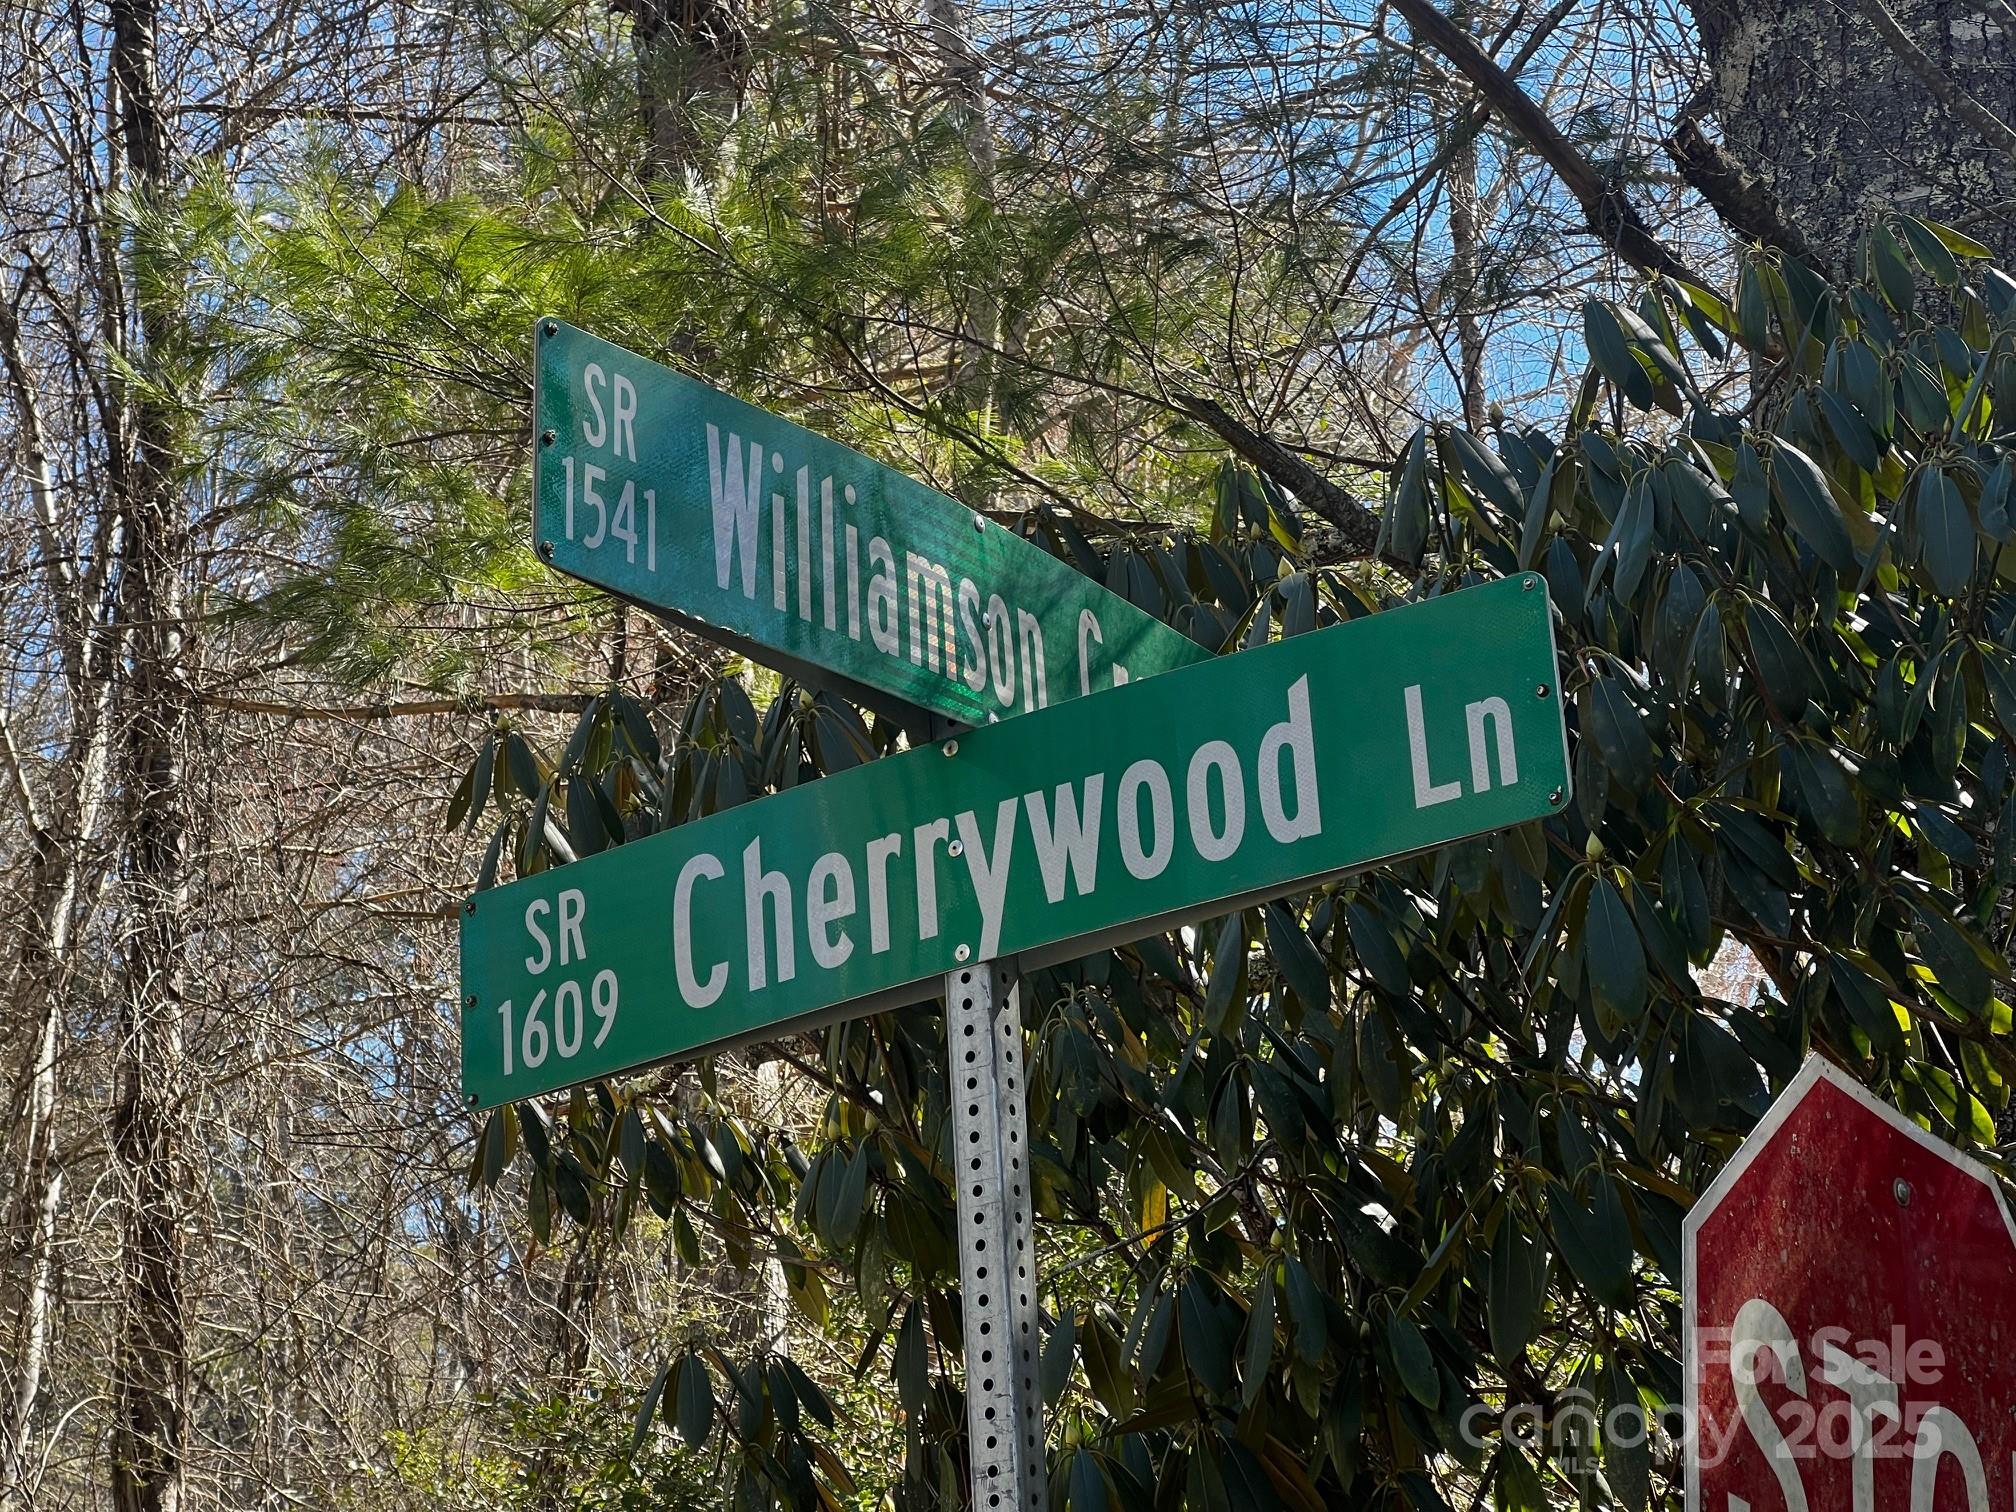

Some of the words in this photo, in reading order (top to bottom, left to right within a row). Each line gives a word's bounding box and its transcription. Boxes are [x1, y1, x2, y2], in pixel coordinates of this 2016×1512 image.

[582, 363, 638, 462] SR
[562, 456, 656, 572] 1541
[706, 422, 1047, 713] Williamson
[673, 672, 1322, 1009] Cherrywood
[1404, 683, 1519, 808] Ln
[525, 888, 587, 975] SR
[498, 968, 619, 1076] 1609
